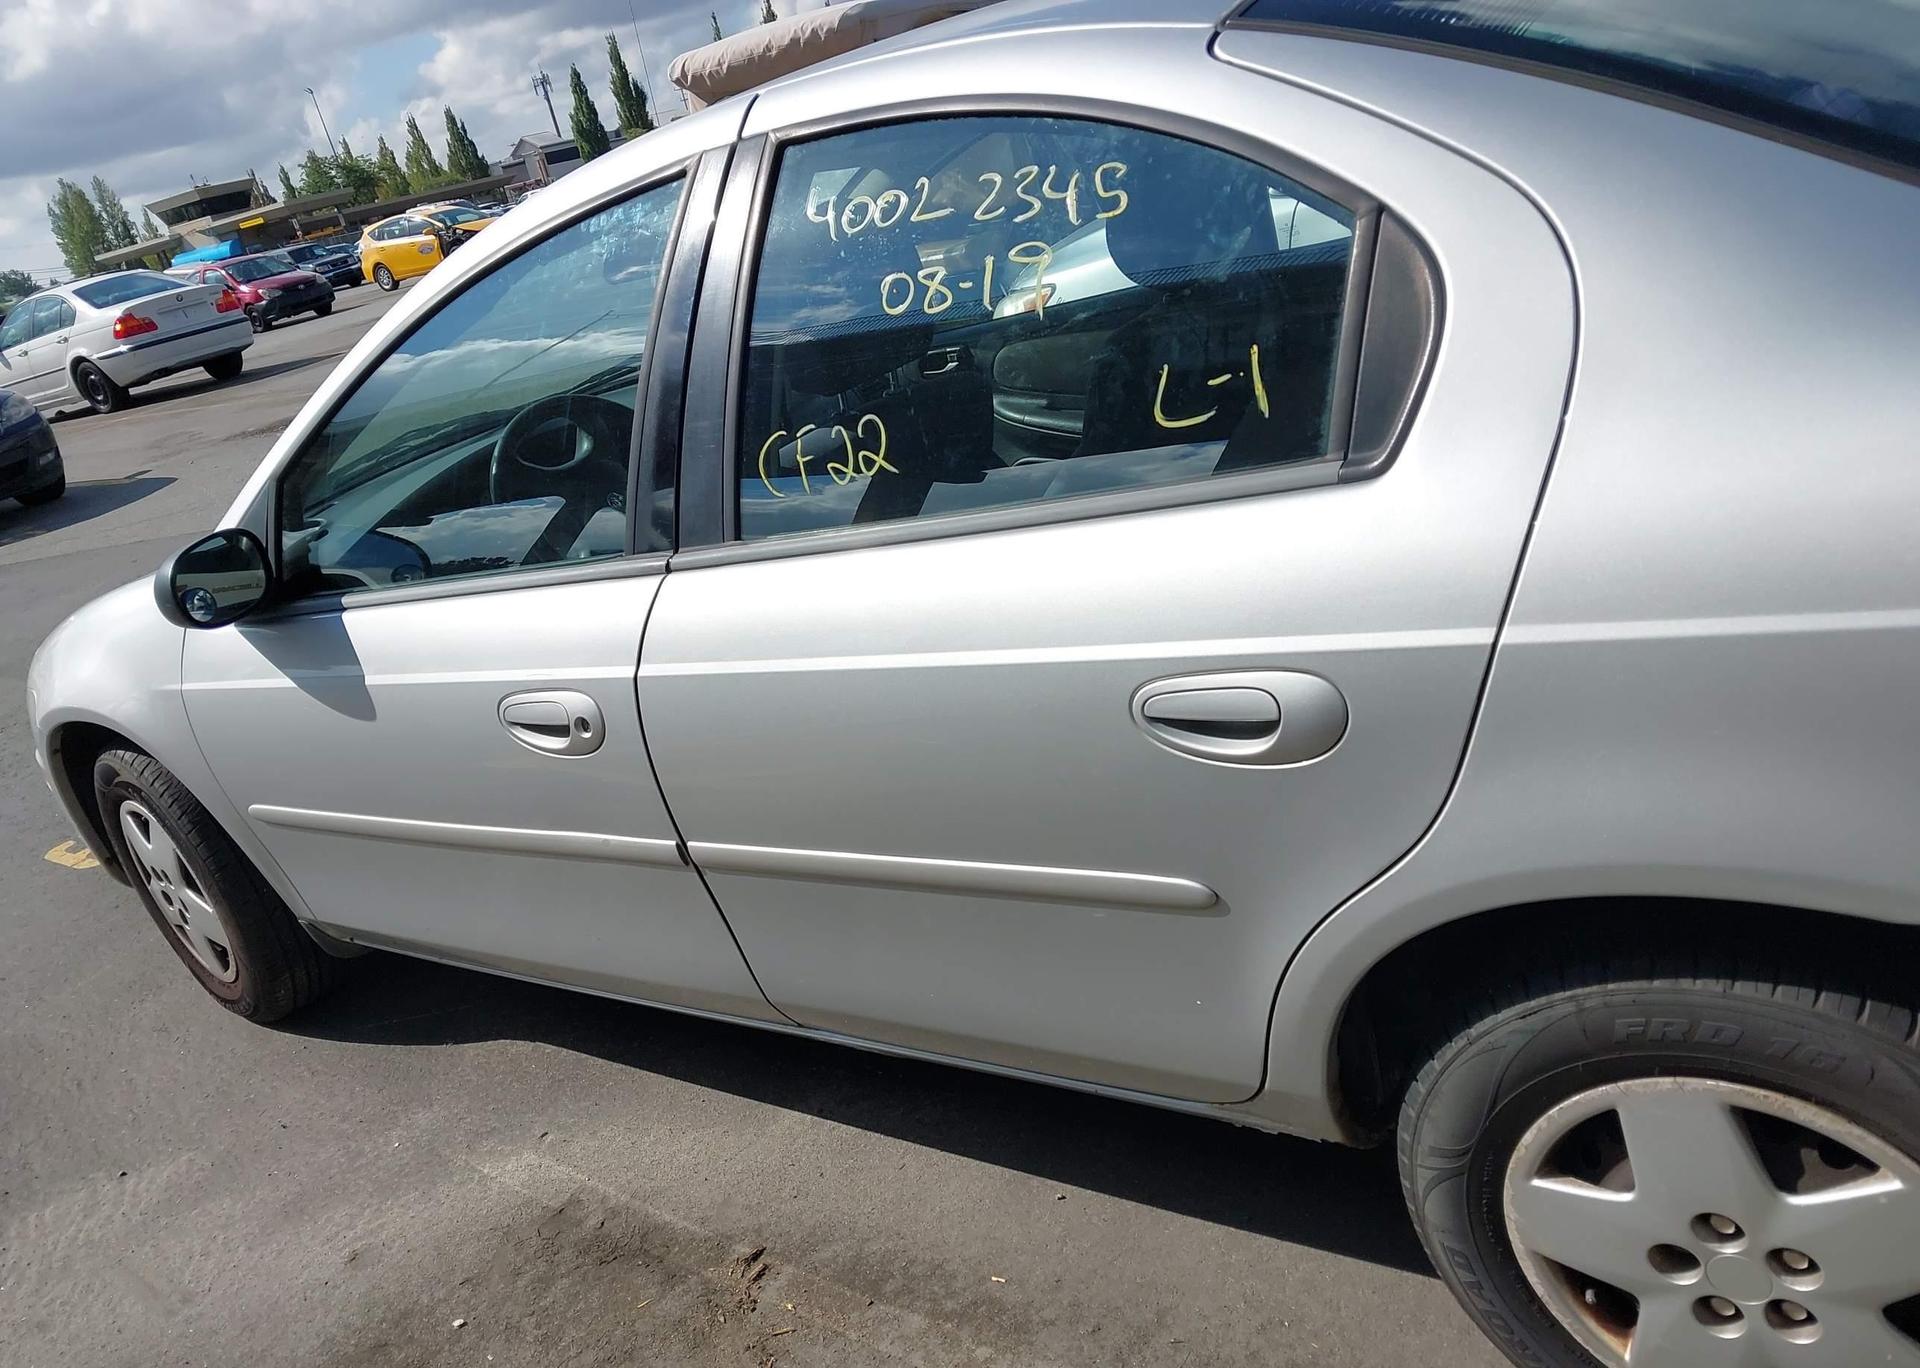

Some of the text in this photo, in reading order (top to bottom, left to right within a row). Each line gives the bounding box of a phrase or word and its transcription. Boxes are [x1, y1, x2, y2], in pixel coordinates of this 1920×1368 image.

[806, 161, 1129, 243] 4002 2345
[880, 241, 1054, 321] 08-19
[758, 413, 900, 498] CF22
[1614, 1017, 1746, 1048] FRD
